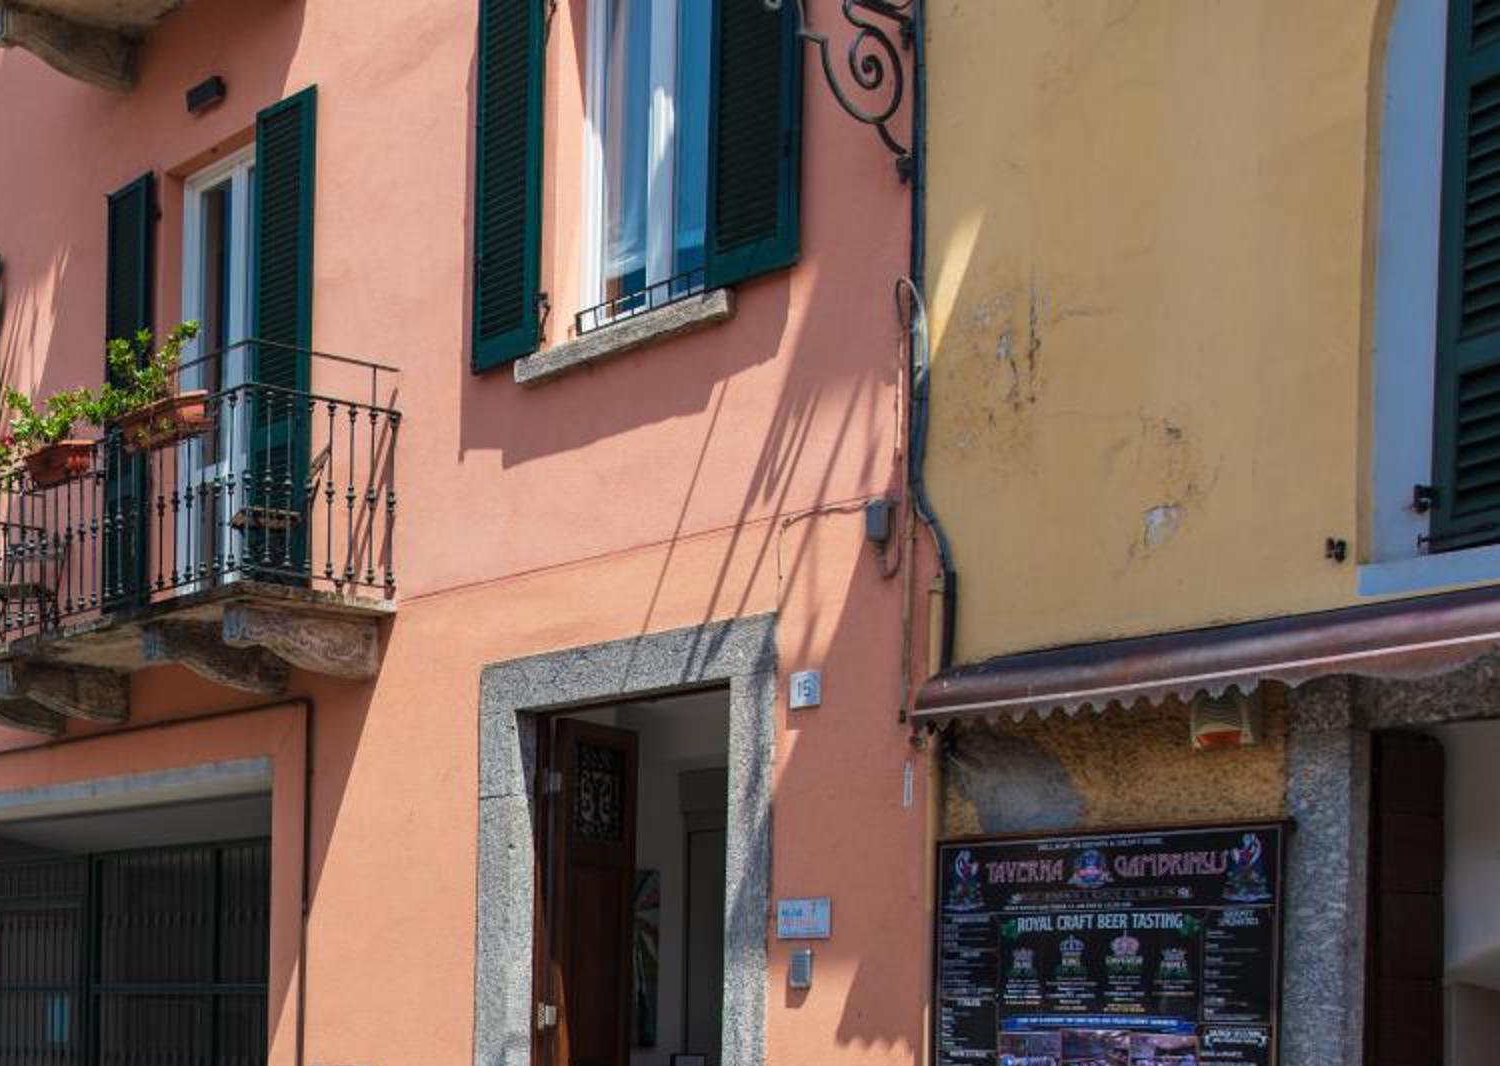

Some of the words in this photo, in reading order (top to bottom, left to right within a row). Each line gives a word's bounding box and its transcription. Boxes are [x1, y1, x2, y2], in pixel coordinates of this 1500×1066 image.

[987, 858, 1063, 884] TAVERNA
[1017, 915, 1053, 932] ROYAL
[1056, 913, 1095, 930] CRAFT
[1099, 913, 1128, 929] BEER
[1132, 912, 1183, 929] TASTING
